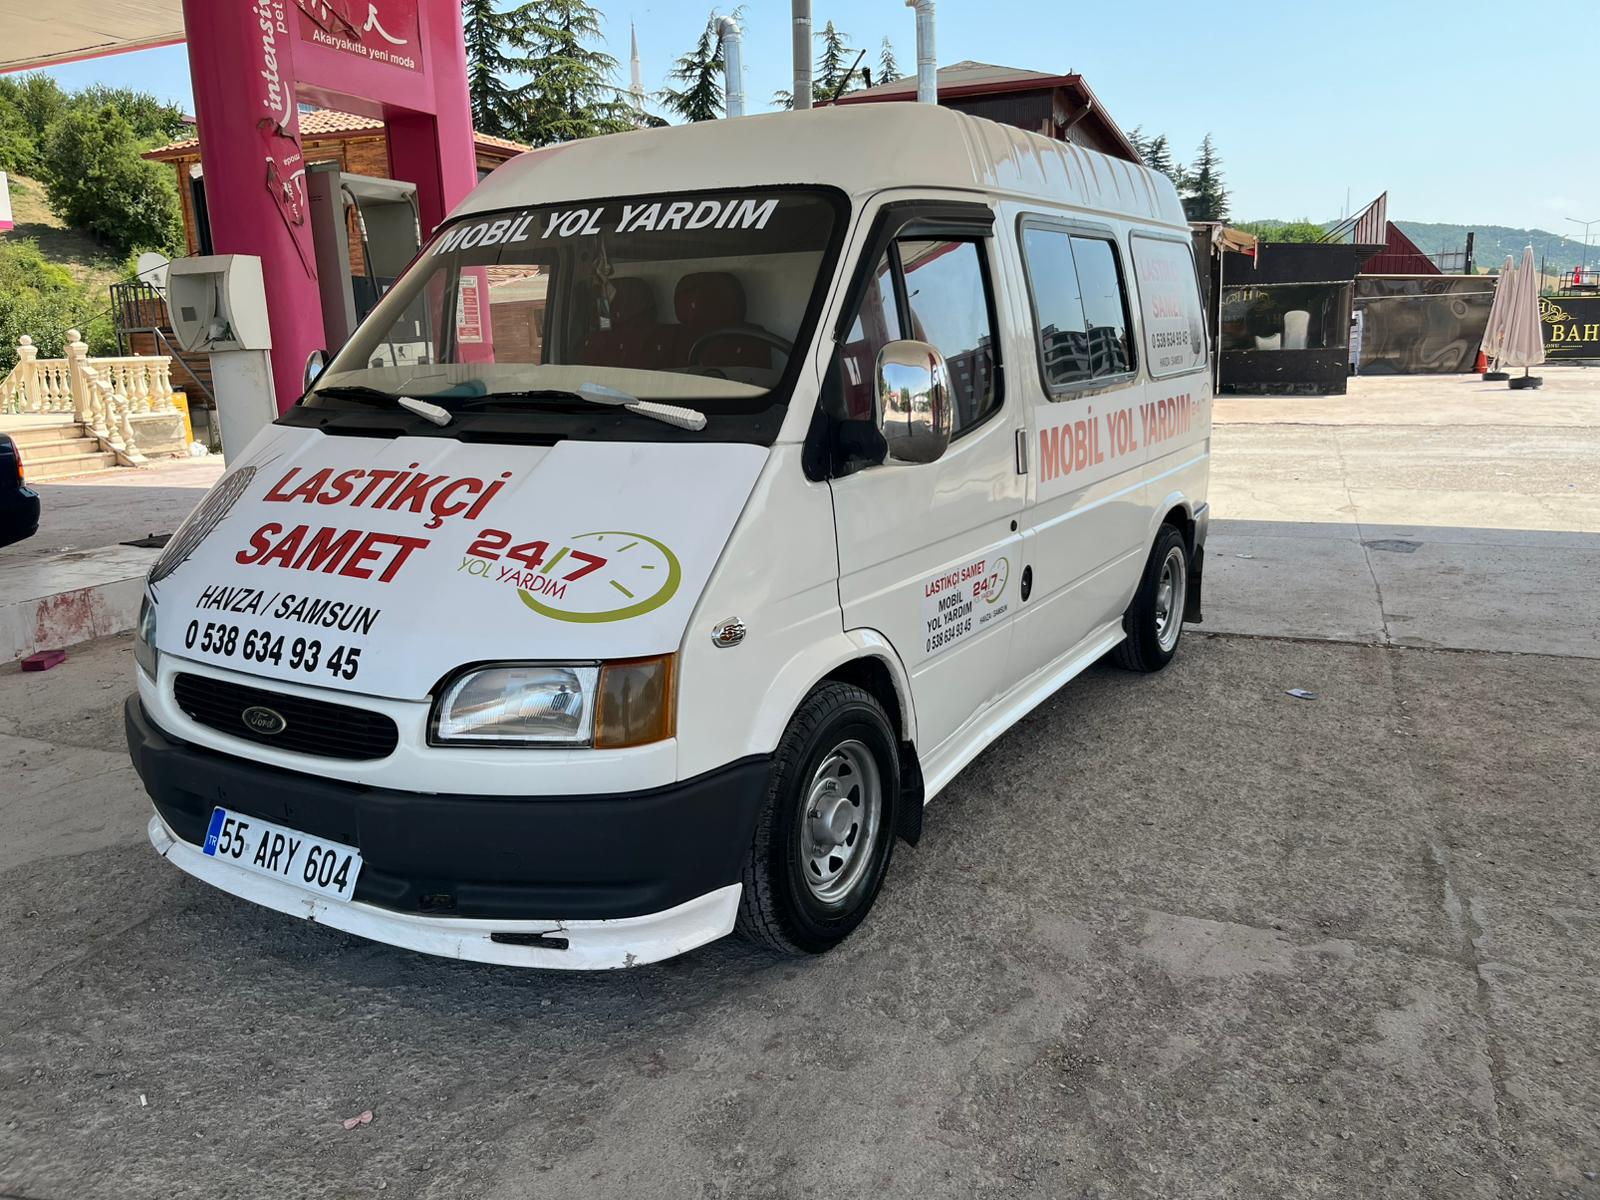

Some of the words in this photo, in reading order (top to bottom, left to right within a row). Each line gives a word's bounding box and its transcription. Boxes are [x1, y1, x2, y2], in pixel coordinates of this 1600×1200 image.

[313, 29, 367, 56] Akaryakıtta
[369, 47, 389, 61] yeni
[390, 54, 415, 69] moda
[432, 210, 534, 257] MOBİL
[541, 207, 605, 239] YOL
[614, 199, 780, 233] YARDIM
[1551, 323, 1600, 342] BAH
[1040, 405, 1104, 483] MOBİL
[1106, 407, 1137, 458] YOL
[1139, 393, 1191, 448] YARDIM
[263, 462, 512, 529] LASTİKÇİ
[235, 522, 431, 583] SAMET
[466, 528, 608, 582] 24/7
[457, 556, 497, 579] YOL
[496, 565, 568, 600] YARDIM
[925, 567, 960, 597] LASTİKÇİ
[961, 560, 985, 582] SAMET
[938, 590, 963, 613] MOBİL
[196, 585, 264, 616] HAVZA
[274, 594, 381, 635] SAMSUN
[927, 617, 942, 633] YOL
[943, 601, 972, 625] YARDIM
[185, 620, 199, 649] 0
[201, 622, 239, 656] 538
[243, 629, 285, 666] 634
[289, 638, 322, 672] 93
[326, 646, 361, 680] 45
[926, 638, 931, 653] 0
[932, 633, 943, 650] 538
[944, 625, 955, 643] 634
[956, 621, 963, 637] 93
[964, 618, 971, 632] 45
[250, 711, 276, 729] Ford
[208, 834, 218, 847] TR
[219, 818, 249, 859] 55
[253, 830, 301, 876] ARY
[303, 845, 353, 894] 604
